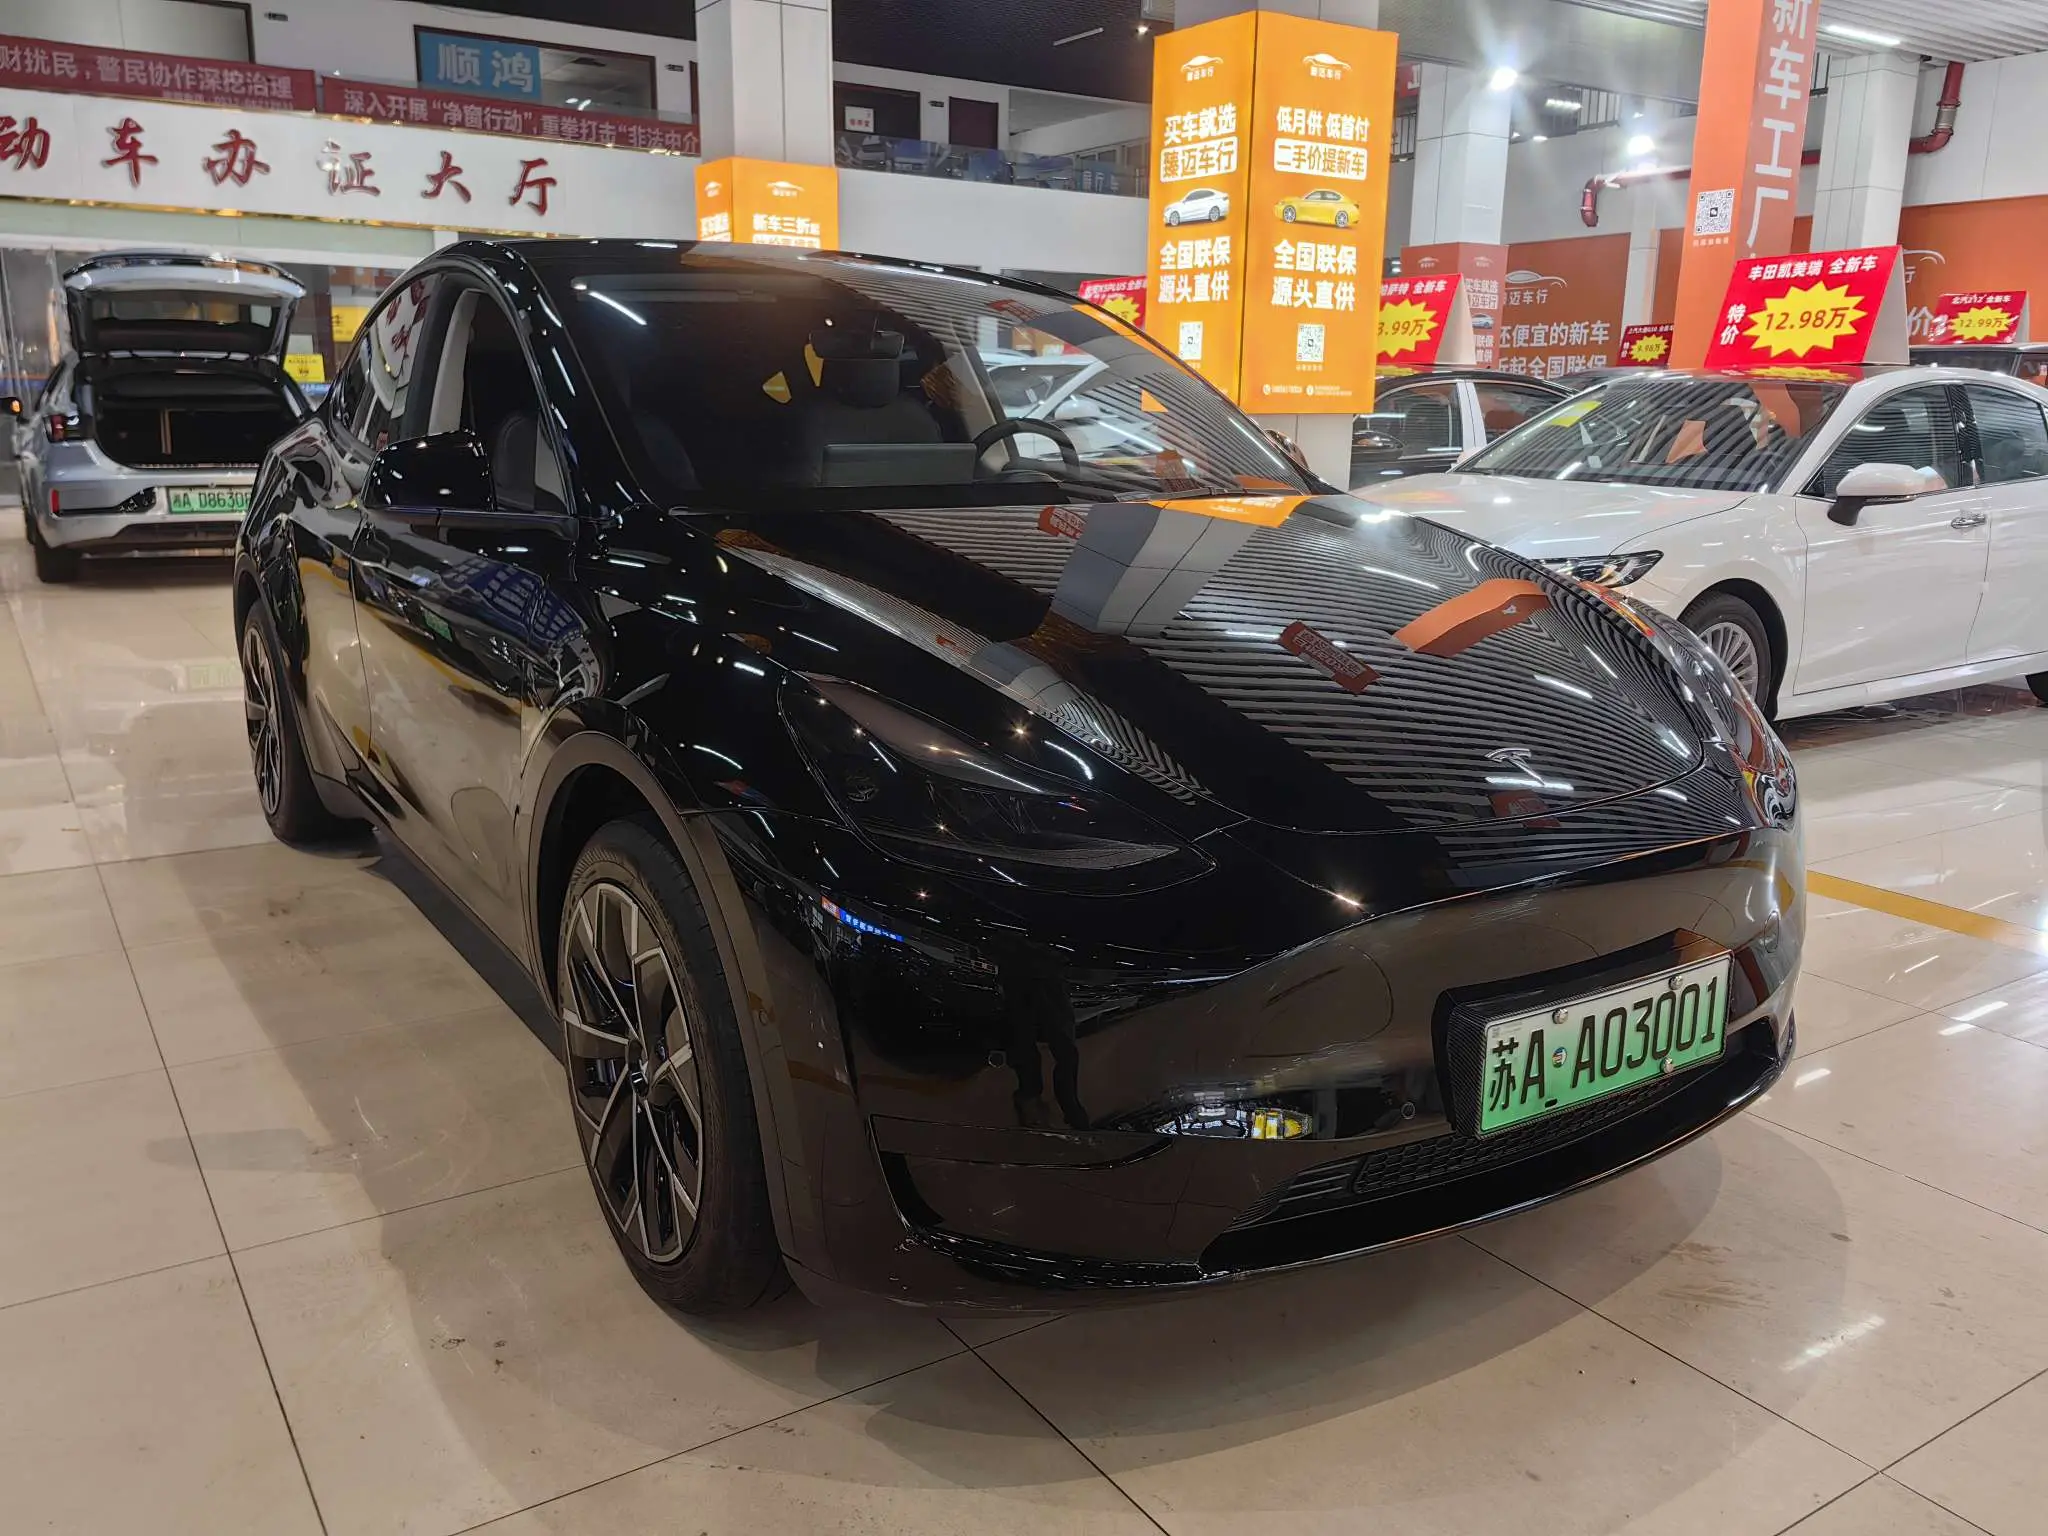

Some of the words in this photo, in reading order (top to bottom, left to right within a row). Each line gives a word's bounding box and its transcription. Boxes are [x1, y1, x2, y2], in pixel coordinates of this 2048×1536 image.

[437, 44, 534, 93] 顺鸿
[1164, 103, 1237, 146] 买车就选
[1276, 105, 1322, 137] 低月供
[1326, 111, 1370, 143] 低首付
[1163, 140, 1235, 180] 臻迈车行
[1277, 143, 1365, 177] 二手价提新车
[1159, 236, 1231, 270] 全国联保
[1273, 239, 1357, 275] 全国联保
[1748, 258, 1823, 282] 丰田凯美瑞
[1829, 254, 1879, 275] 全新车
[1158, 271, 1230, 303] 源头直供
[1271, 276, 1356, 311] 源头直供
[1413, 280, 1447, 294] 全新车
[1467, 295, 1498, 308] 迈车行
[1504, 288, 1549, 306] 迈车行
[1985, 294, 2012, 303] 全新车
[1719, 303, 1745, 346] 特价
[1764, 305, 1850, 332] 12.98万
[1959, 317, 2005, 328] 12.99万
[1488, 1028, 1545, 1112] 苏A
[1571, 976, 1718, 1089] A03001
